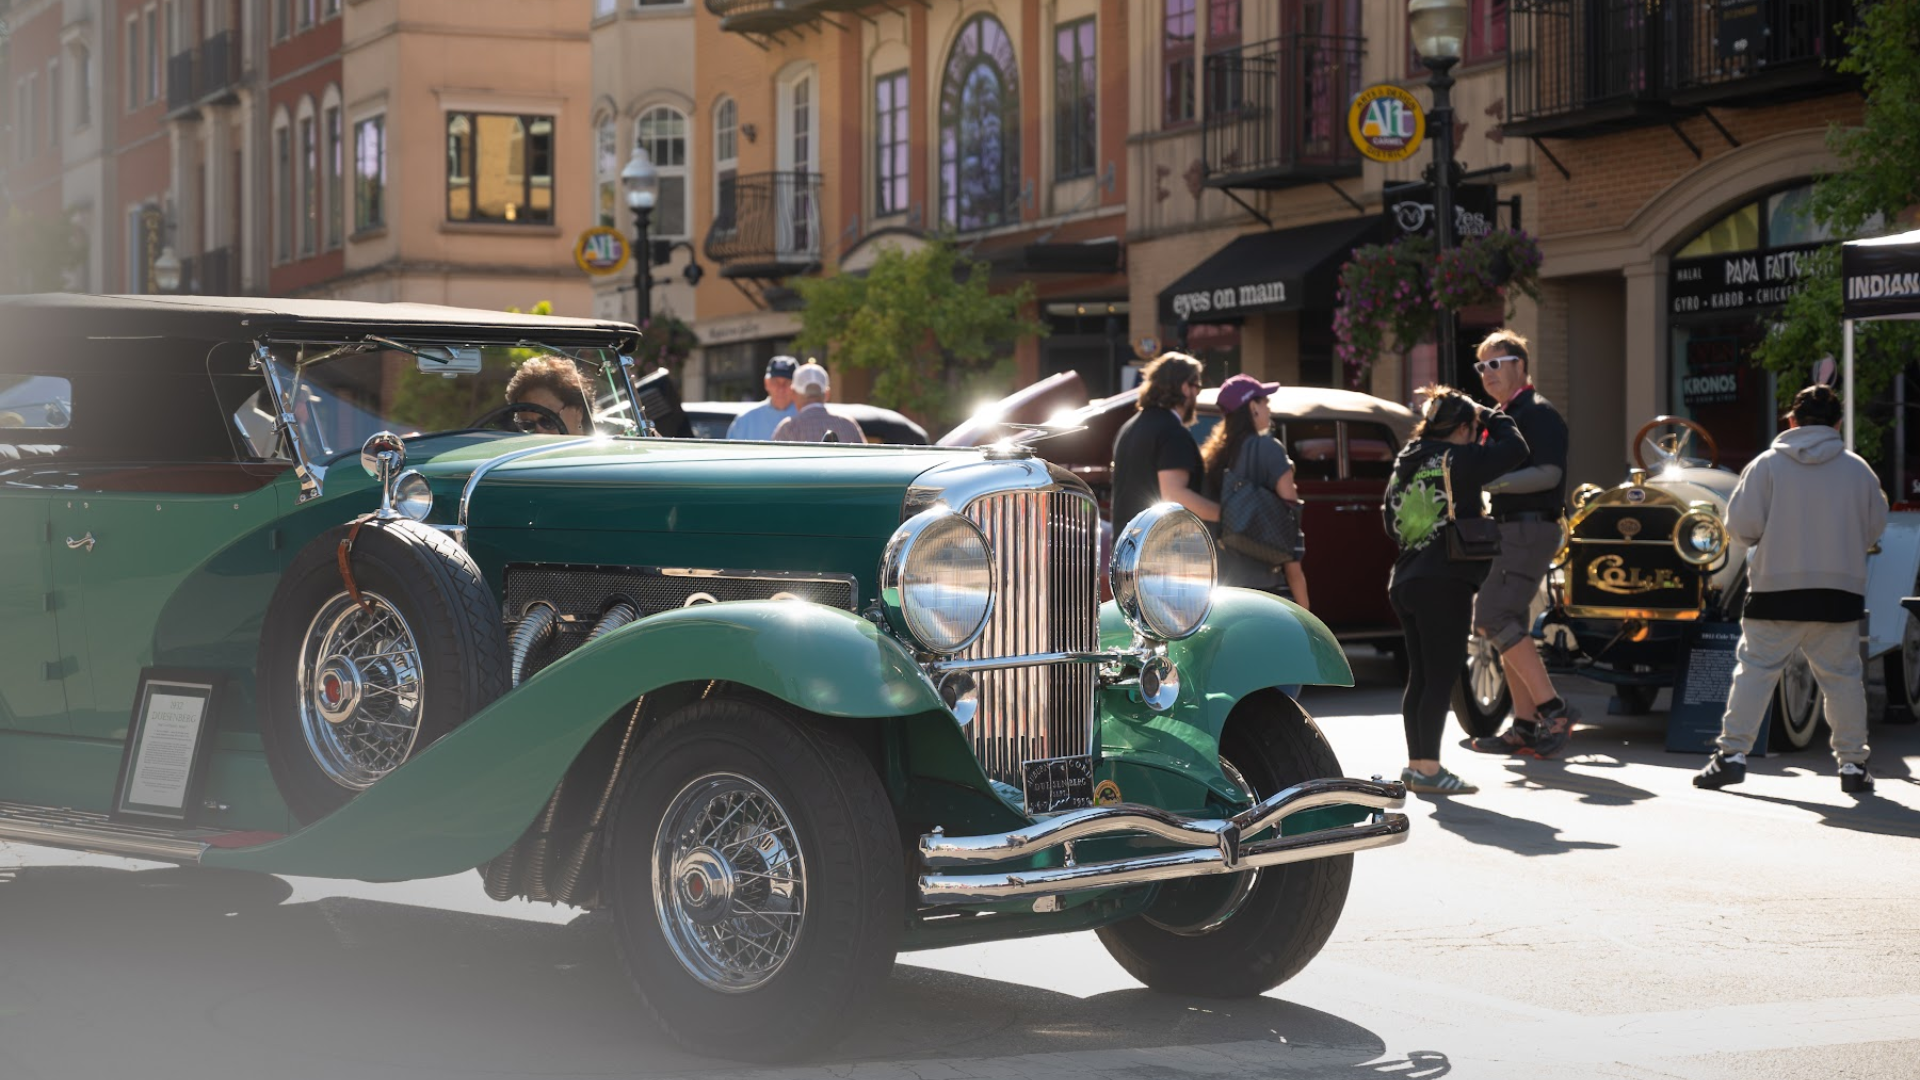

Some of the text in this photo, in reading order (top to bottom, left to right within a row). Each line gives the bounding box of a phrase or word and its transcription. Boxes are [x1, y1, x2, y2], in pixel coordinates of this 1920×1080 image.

[1676, 267, 1702, 281] HALAL
[1725, 257, 1760, 284] PAPA
[1173, 281, 1286, 320] eyes on main
[1674, 296, 1699, 312] GYRO
[1711, 291, 1744, 309] KABOB
[1684, 374, 1737, 394] KRONOS
